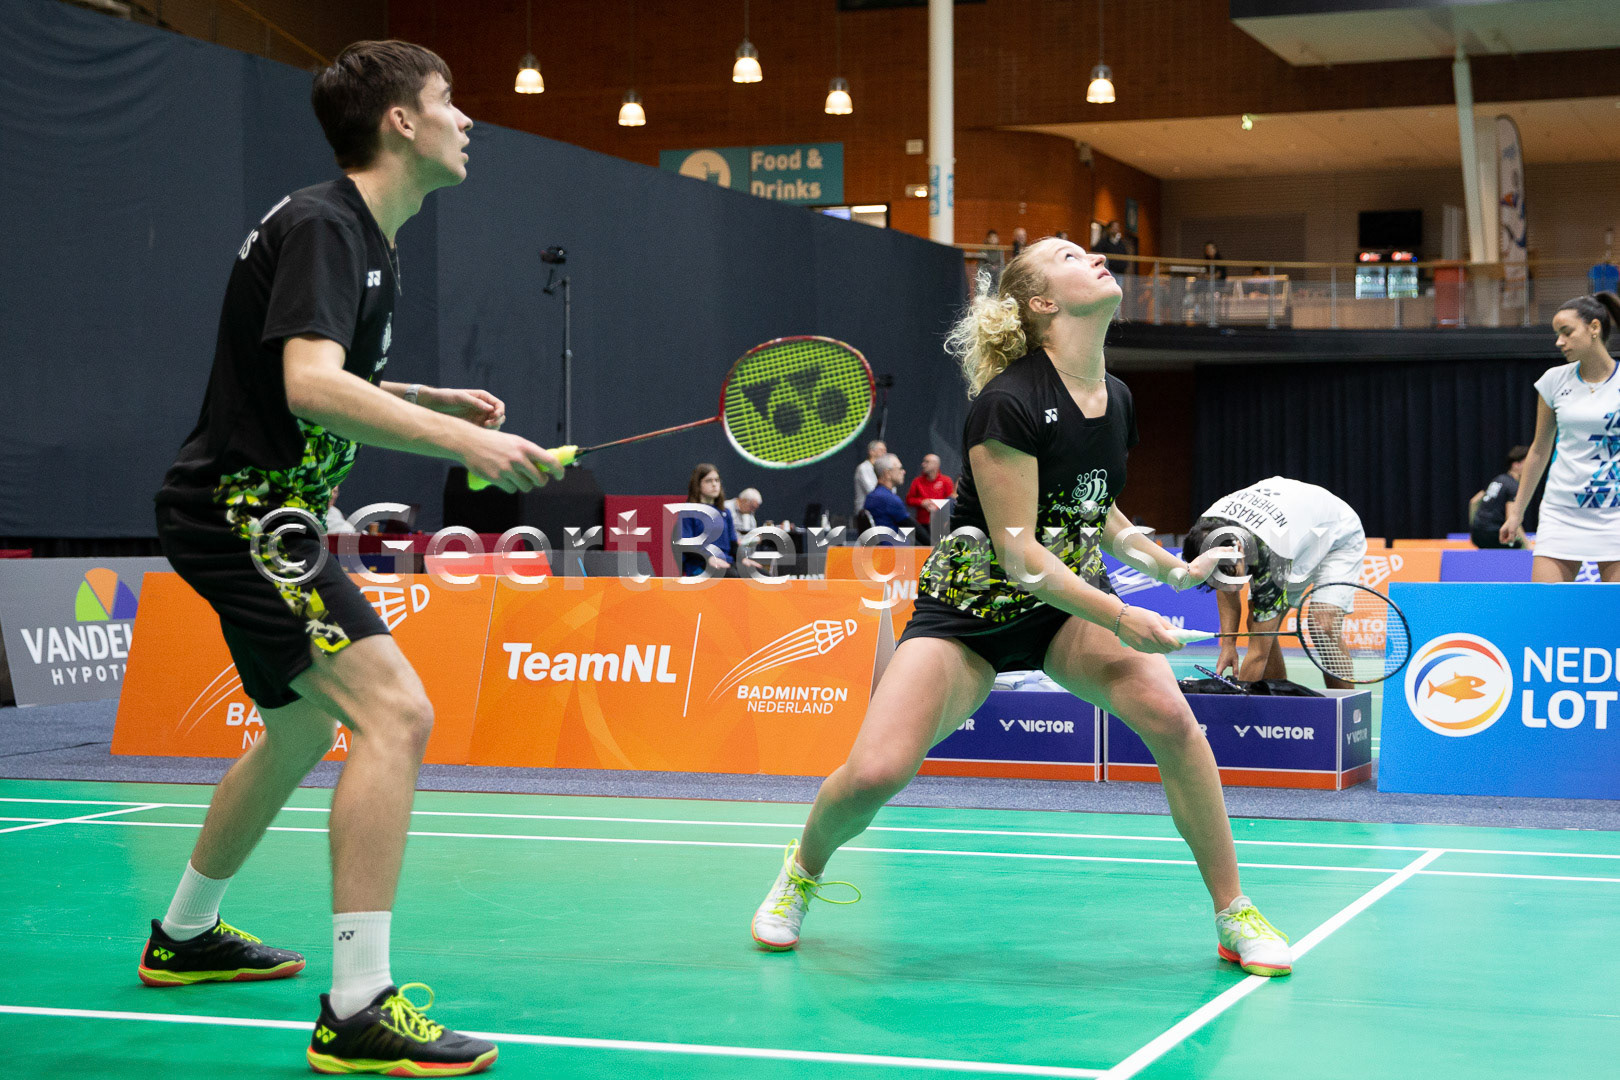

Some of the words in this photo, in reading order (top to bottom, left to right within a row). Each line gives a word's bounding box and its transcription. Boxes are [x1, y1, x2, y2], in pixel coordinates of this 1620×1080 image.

[750, 150, 801, 171] Food
[806, 148, 824, 170] &
[750, 179, 823, 200] Drinks
[1221, 501, 1267, 529] HAASE
[1236, 491, 1288, 528] NETHERLA
[502, 642, 677, 684] TeamNL
[1523, 646, 1620, 683] NED
[737, 685, 848, 702] BADMINTON
[747, 701, 834, 715] NEDERLAND
[1018, 719, 1074, 733] VICTOR
[1253, 725, 1315, 740] VICTOR
